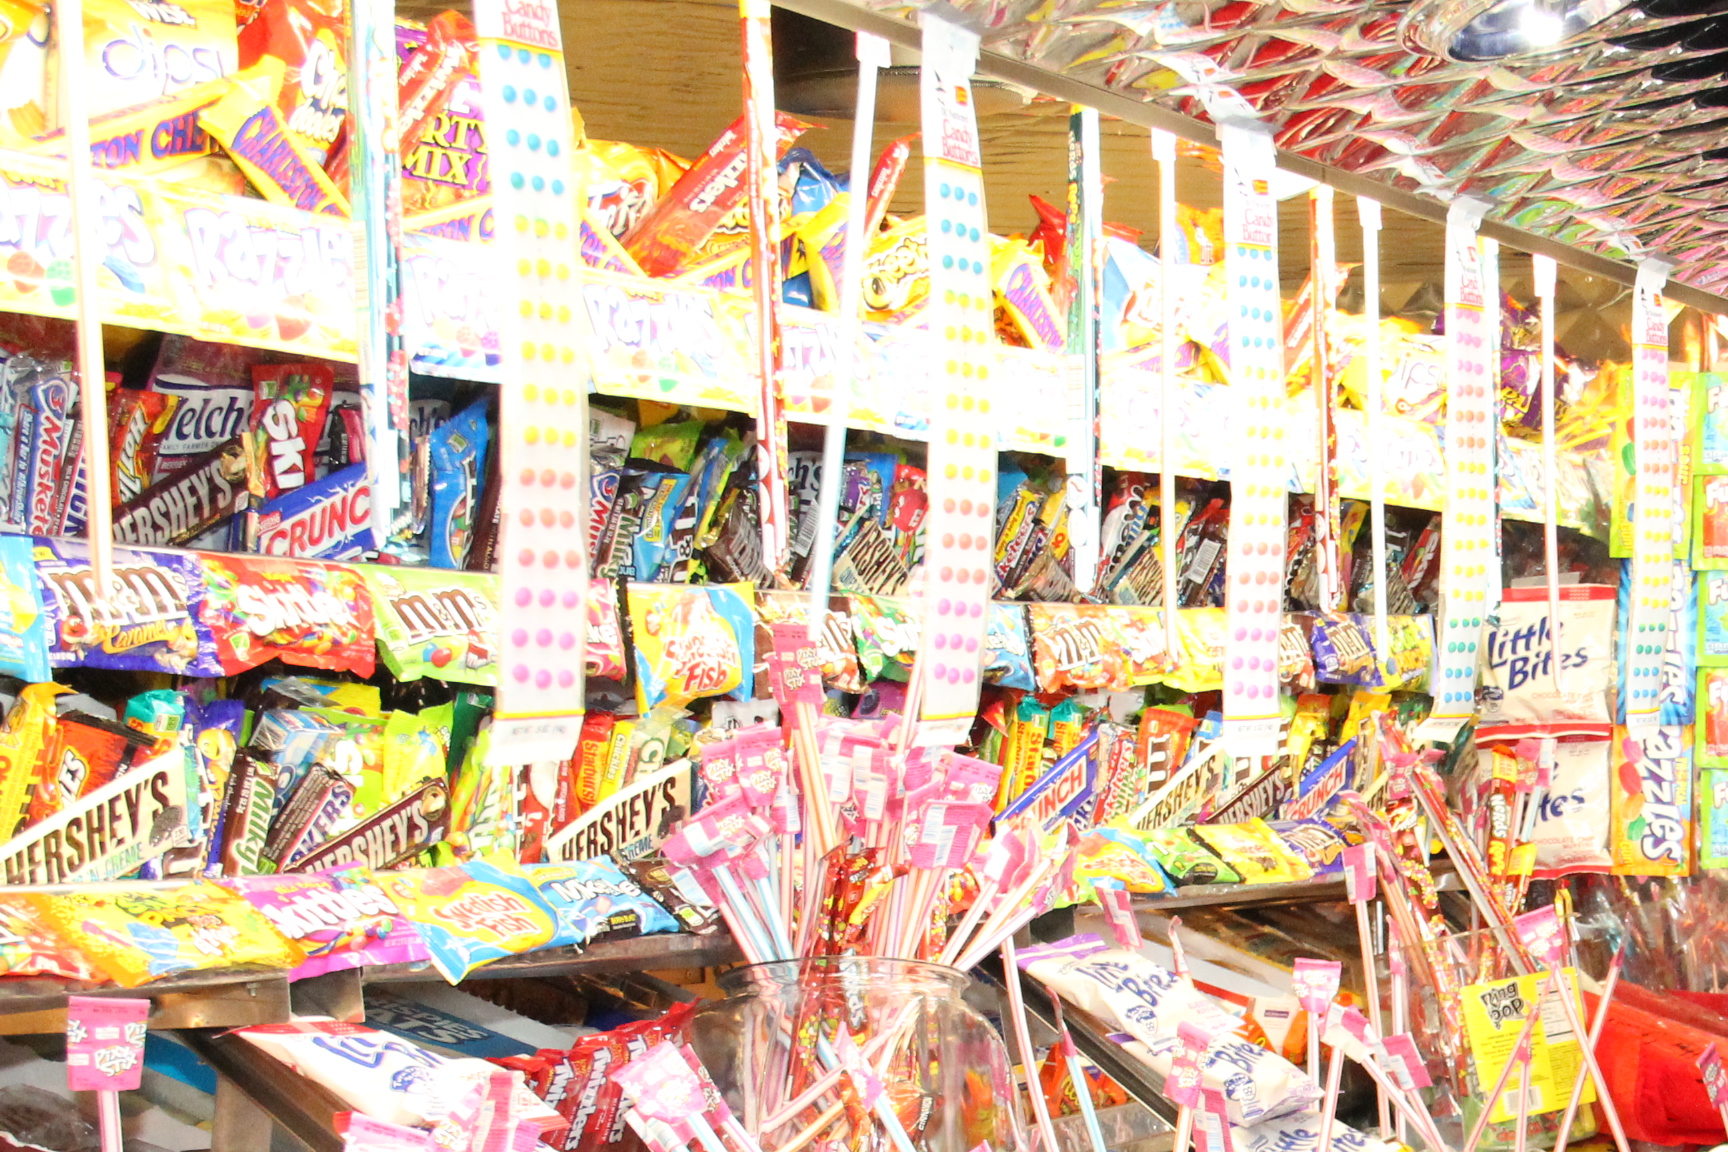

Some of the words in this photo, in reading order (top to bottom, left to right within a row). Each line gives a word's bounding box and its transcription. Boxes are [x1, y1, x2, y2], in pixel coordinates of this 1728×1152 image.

[501, 12, 559, 47] Buttons
[505, 0, 551, 28] Candy
[941, 136, 979, 166] Buttons
[943, 118, 973, 149] Candy
[1244, 207, 1275, 230] Candy
[183, 207, 356, 294] Razzle
[266, 485, 371, 557] CRUNC
[101, 620, 168, 654] Caramel
[1487, 615, 1564, 670] Little
[683, 660, 728, 693] Fish
[1507, 646, 1589, 691] Bites
[3, 771, 171, 886] HERSHEY'S
[561, 775, 677, 861] HERSHEY'S
[260, 884, 399, 939] kittles
[432, 891, 528, 930] Swedish
[474, 913, 543, 942] Fish
[1480, 981, 1518, 1008] Ring
[564, 1046, 613, 1151] Twizzlers
